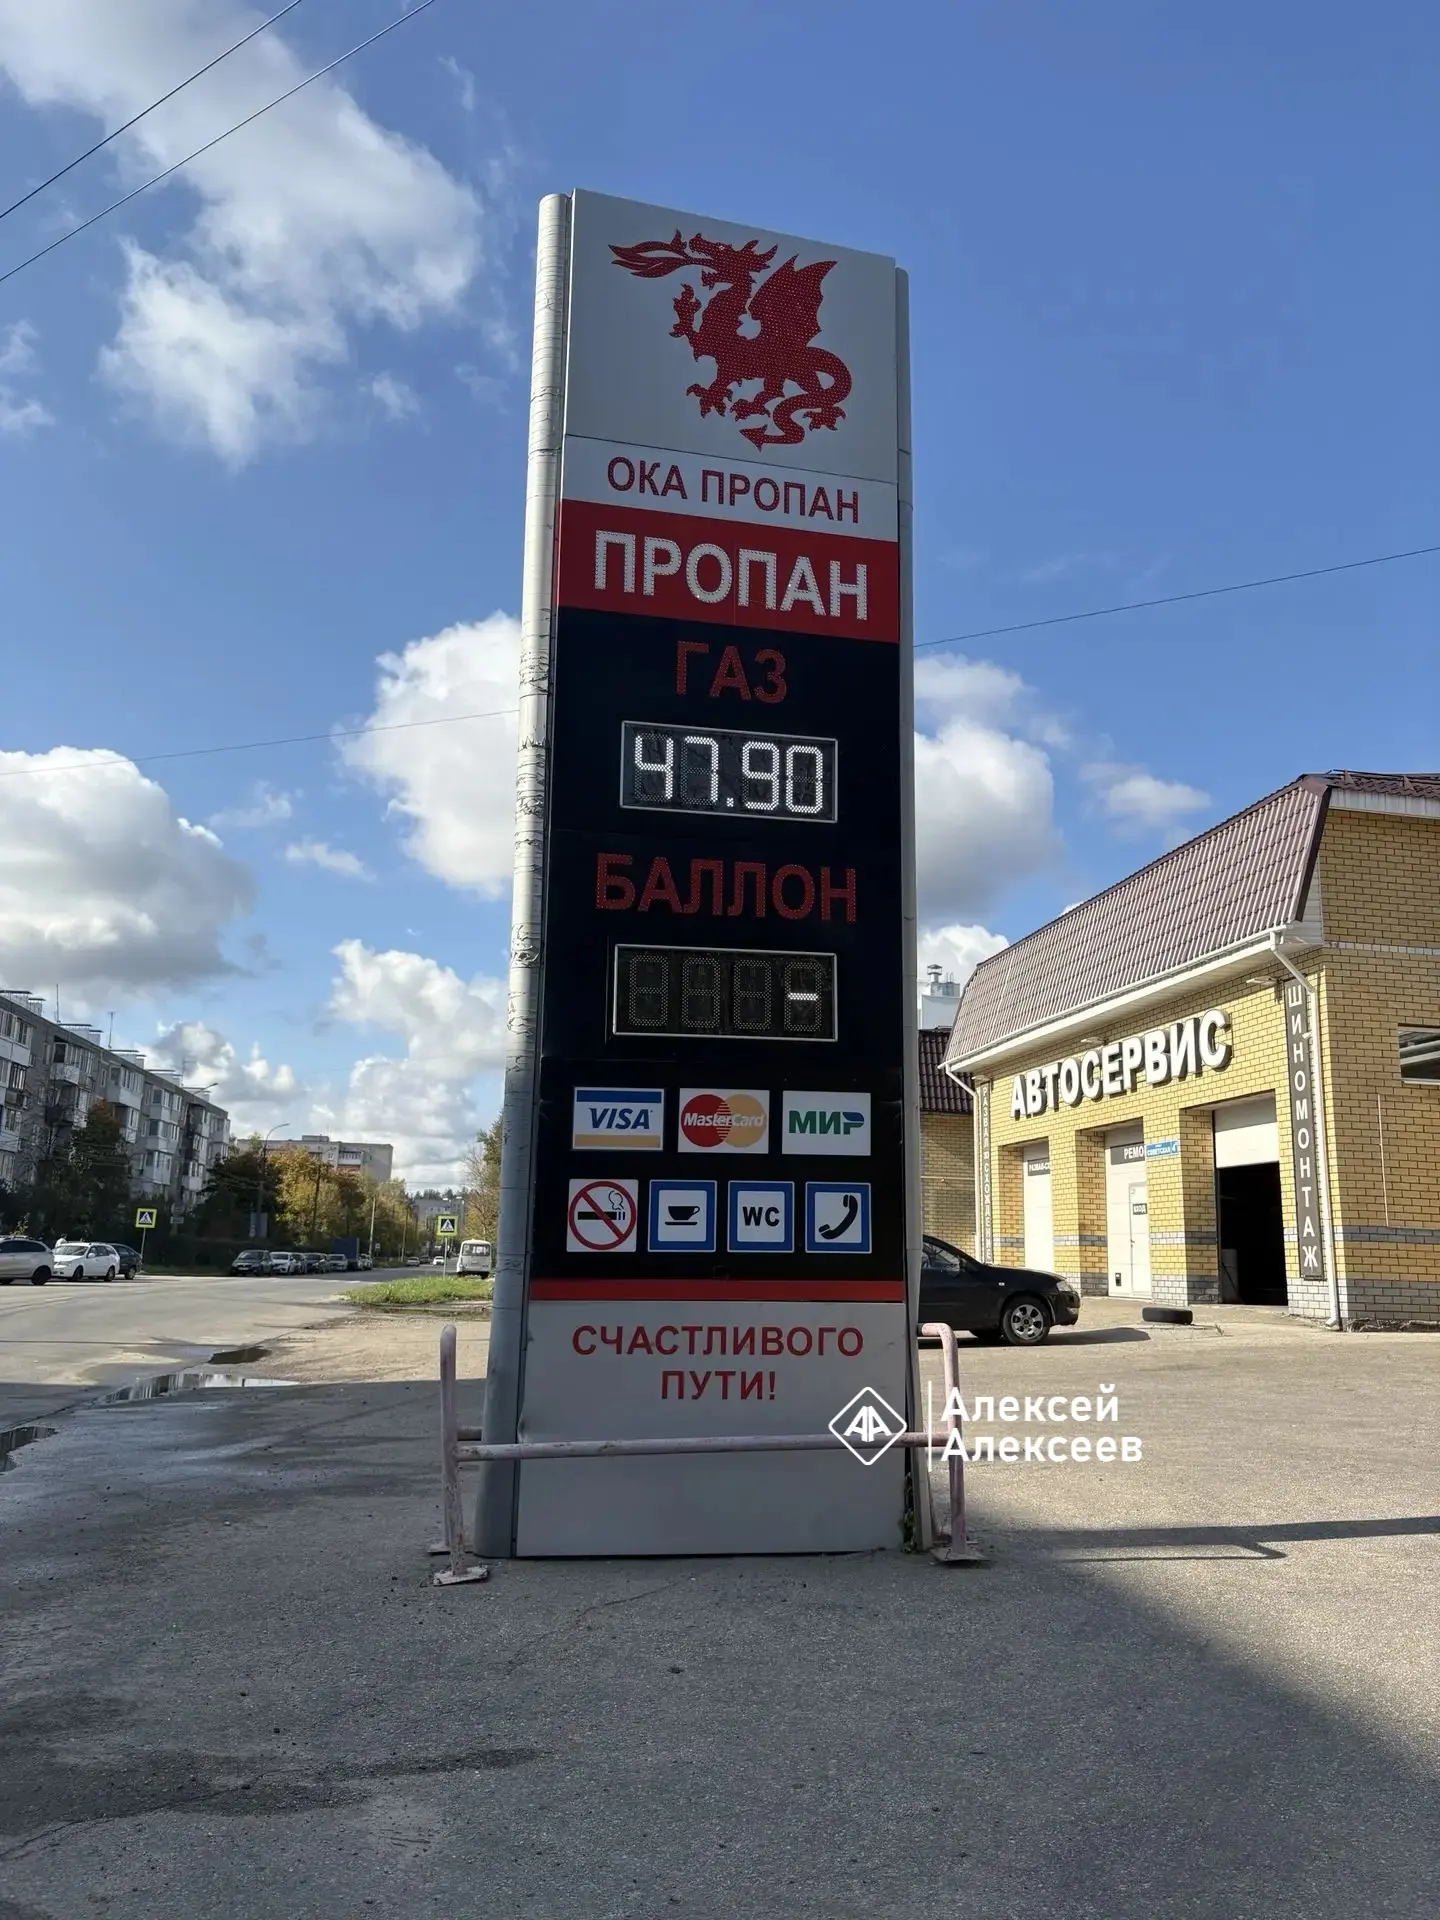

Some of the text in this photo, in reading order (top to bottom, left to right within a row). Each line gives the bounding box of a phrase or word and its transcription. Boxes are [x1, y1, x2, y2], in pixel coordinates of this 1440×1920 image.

[607, 456, 859, 524] ОКА ПРОПАН
[594, 529, 868, 621] ПРОПАН
[675, 639, 788, 703] ГАЗ
[634, 734, 824, 814] 47.90
[594, 852, 857, 924] БАЛЛОН
[1009, 1008, 1230, 1119] АВТОСЕРВИС
[589, 1107, 651, 1130] VISA
[683, 1111, 765, 1127] MasterCard
[789, 1110, 865, 1135] МИР
[1287, 986, 1319, 1270] ШИНОМОНТАЖ
[742, 1206, 780, 1227] WC
[572, 1325, 864, 1357] СЧАСТЛИВОГО
[661, 1370, 776, 1400] ПУТИ!
